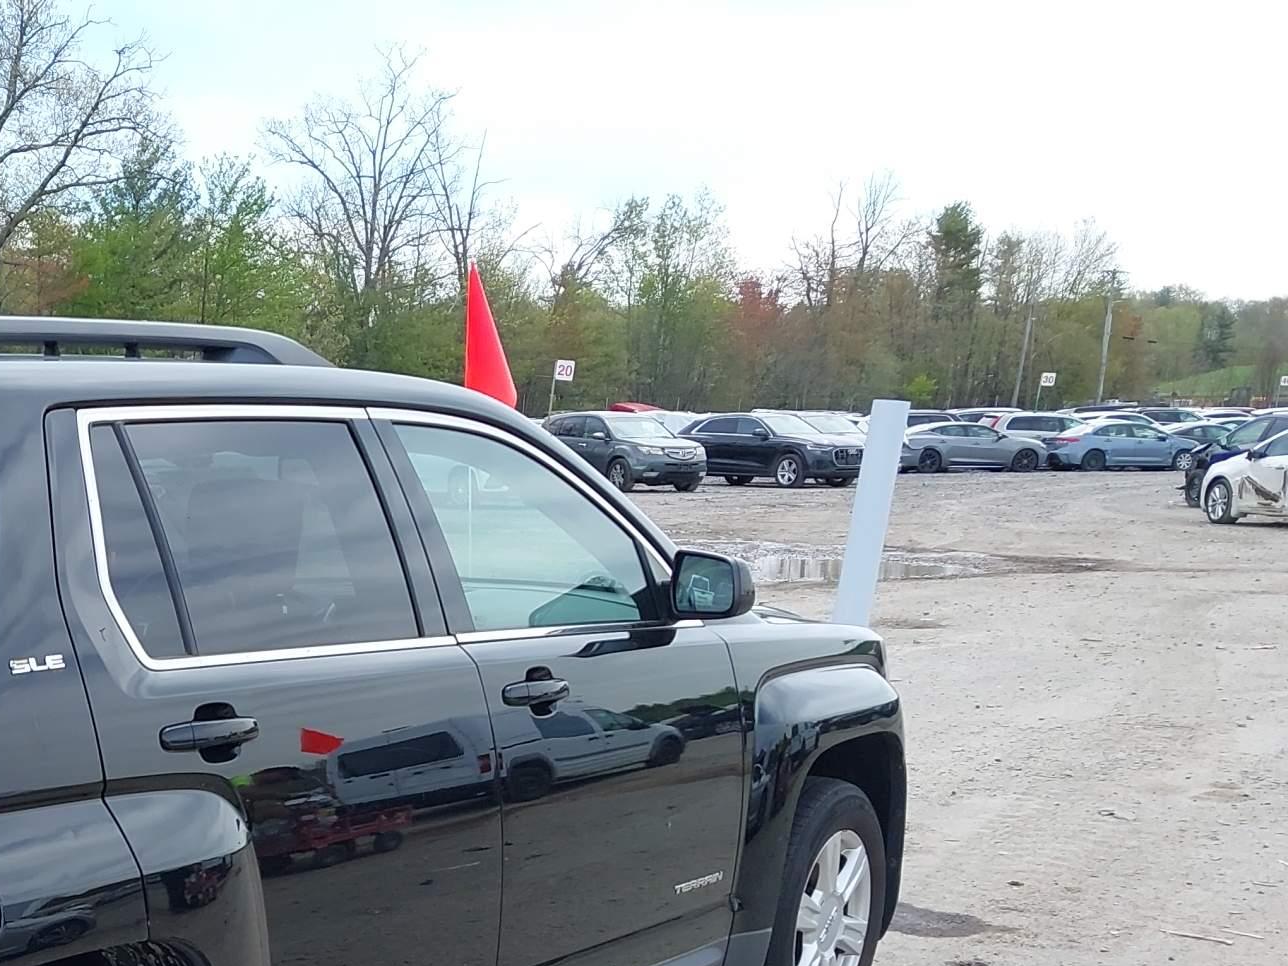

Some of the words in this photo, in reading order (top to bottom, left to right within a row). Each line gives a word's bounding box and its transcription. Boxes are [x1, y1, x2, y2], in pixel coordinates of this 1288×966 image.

[558, 364, 573, 377] 20
[1042, 375, 1054, 384] 30
[9, 654, 66, 675] SLE
